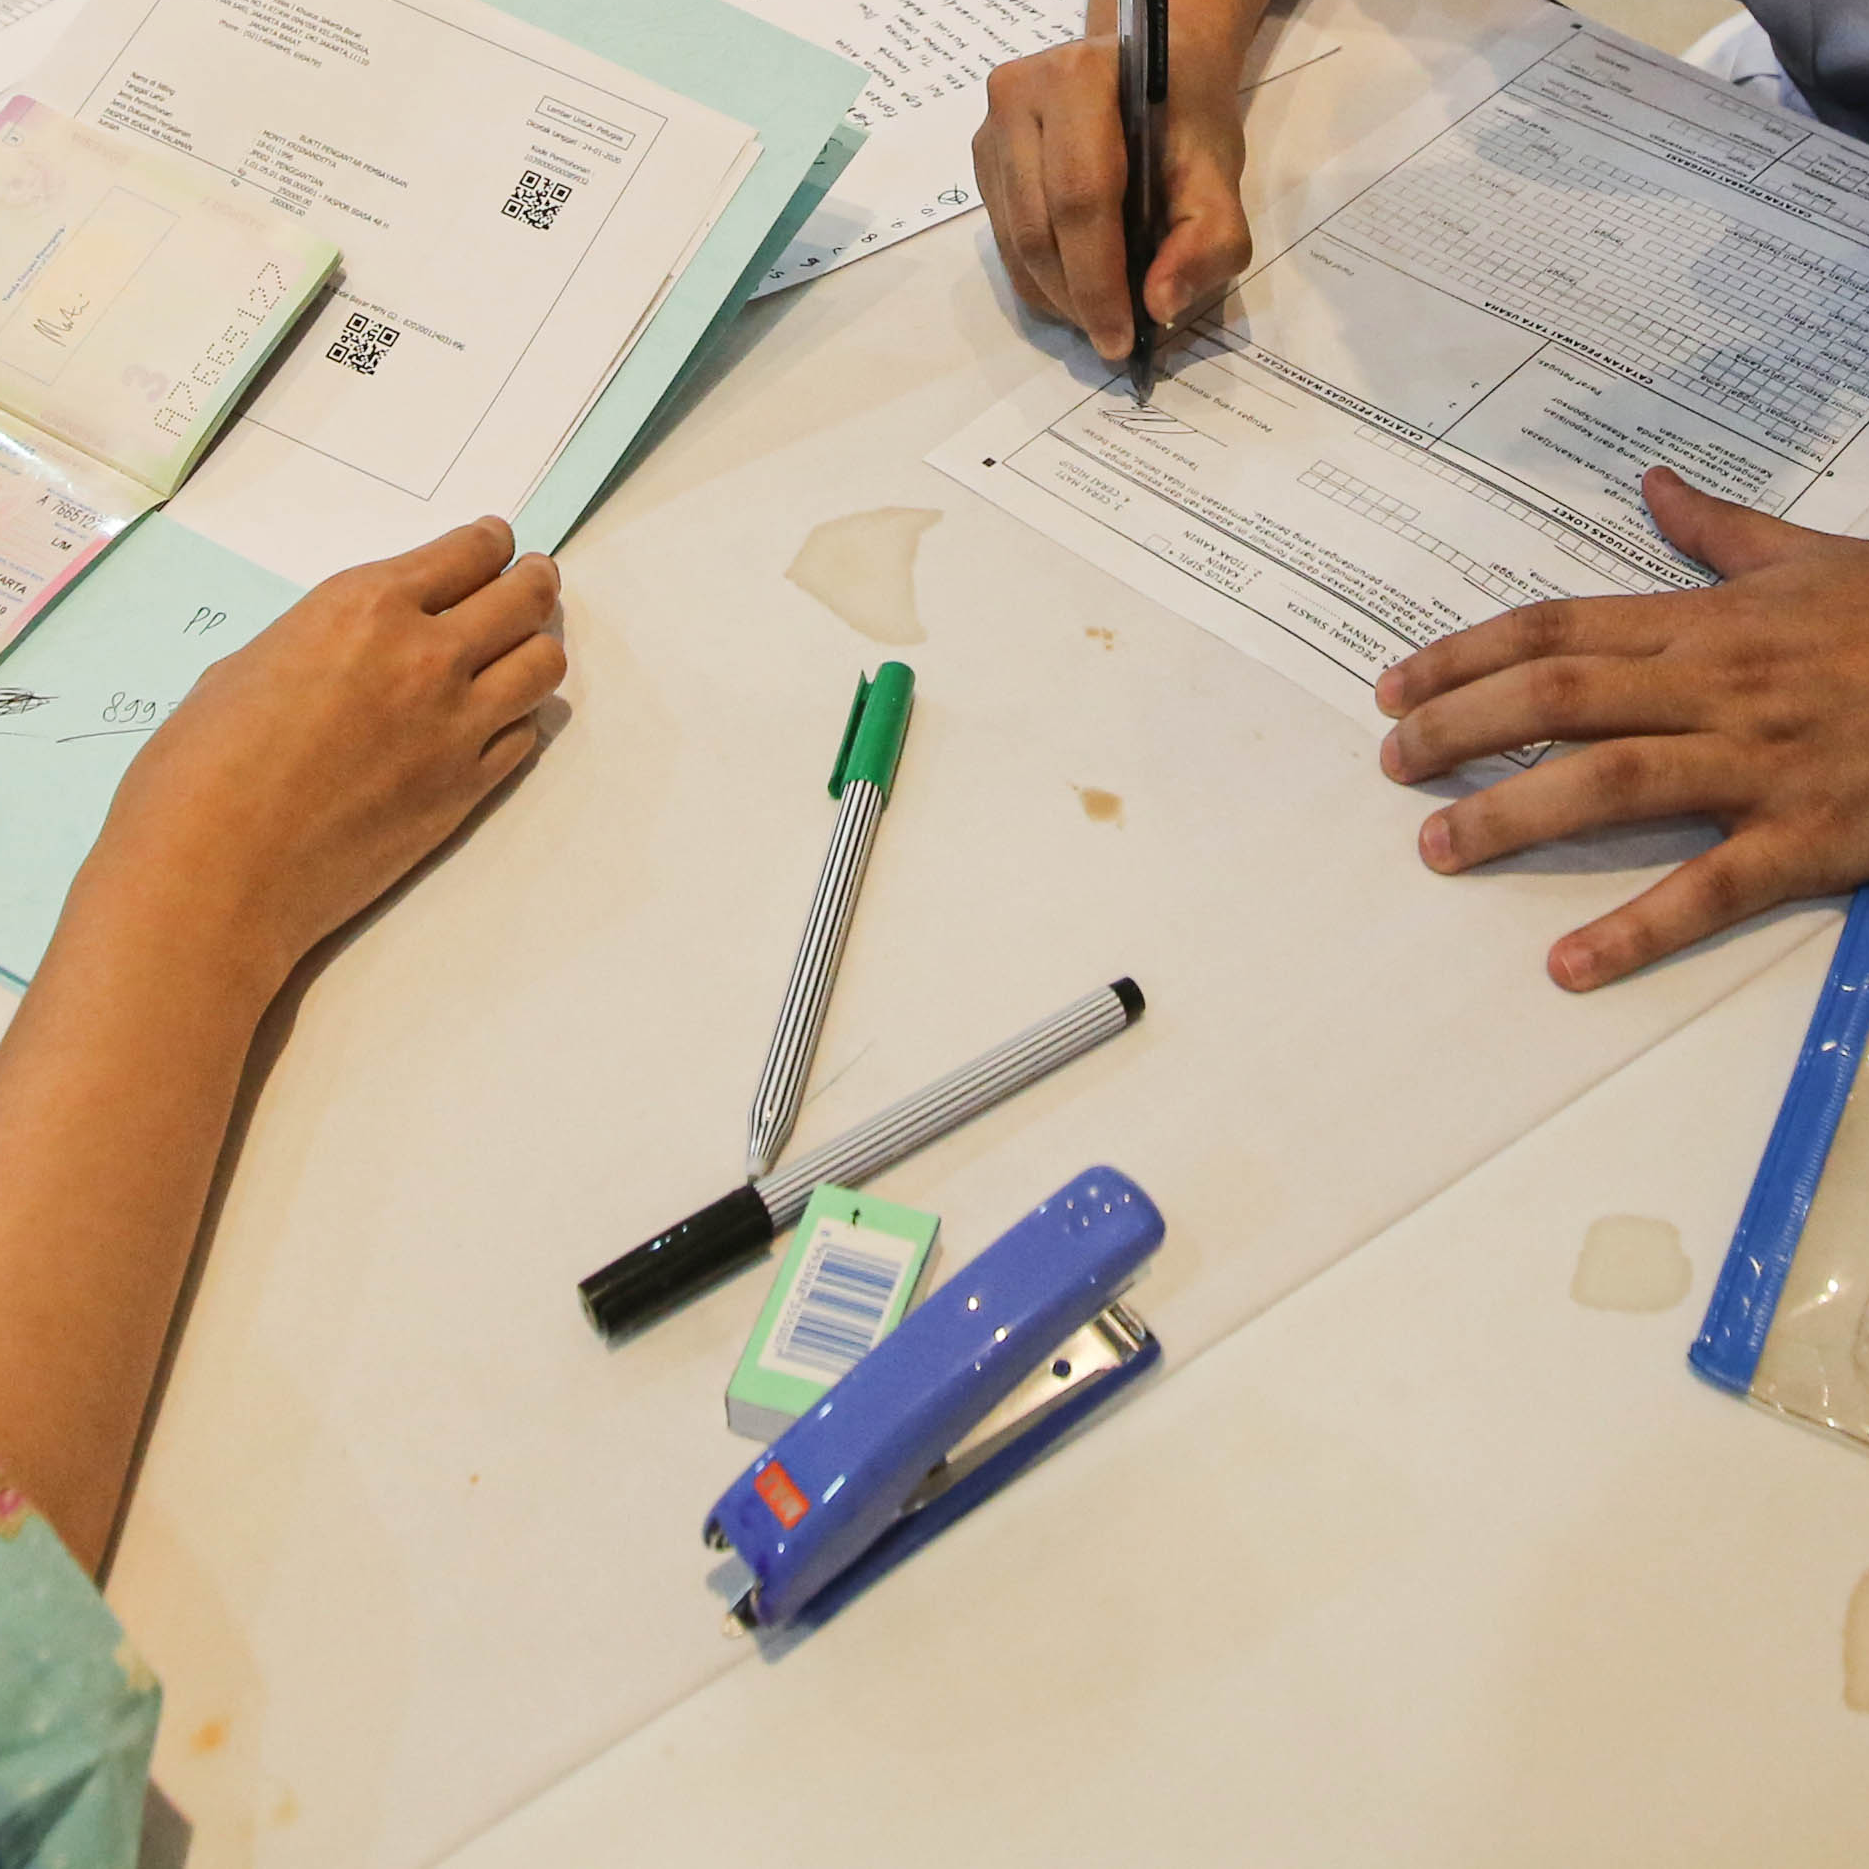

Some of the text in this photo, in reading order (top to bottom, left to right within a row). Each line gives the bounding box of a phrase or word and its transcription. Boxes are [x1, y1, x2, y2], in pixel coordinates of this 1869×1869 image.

[1665, 153, 1717, 177] IMIGRASI
[1718, 175, 1763, 197] PEJABAT
[1763, 194, 1812, 218] CATATAN
[154, 262, 286, 437] A7665127
[1484, 301, 1654, 385] CATATAN PEGAWAI TATA USAHA
[1256, 352, 1423, 441] CATATAN PETUGAS WAWANCARA
[1574, 380, 1602, 396] Paraf
[1236, 410, 1273, 433] Petugas
[1543, 407, 1649, 468] Hilang dari Kepolisian
[1764, 430, 1824, 463] Nama Lama
[1636, 425, 1760, 493] Surat Kuasa/Kartu Tanda
[1658, 427, 1766, 485] Pengenal Pengurusan
[1708, 442, 1773, 479] Keimigrasian
[1055, 470, 1111, 505] CERAI MATI
[1089, 477, 1121, 497] CERAI
[1162, 473, 1186, 489] tidak
[1163, 486, 1183, 498] dan
[36, 494, 50, 506] A
[1183, 497, 1200, 508] sah
[1720, 485, 1749, 504] Surat
[1201, 508, 1234, 527] adalah
[1552, 507, 1701, 590] CATATAN PETUGAS LOKET
[1595, 516, 1662, 555] Persyaratan
[1184, 530, 1248, 571] TIDAK KAWIN
[1205, 556, 1240, 579] KAWIN
[1291, 532, 1434, 619] peraturan perundangan yang
[1488, 562, 1529, 590] tanggal
[1205, 569, 1243, 594] STATUS
[183, 607, 227, 636] PP
[1366, 600, 1391, 618] saya
[1286, 601, 1377, 662] PEGAWAI SWASTA
[1341, 621, 1387, 653] LAINNYA
[1391, 615, 1417, 636] yang
[1417, 620, 1438, 635] dan
